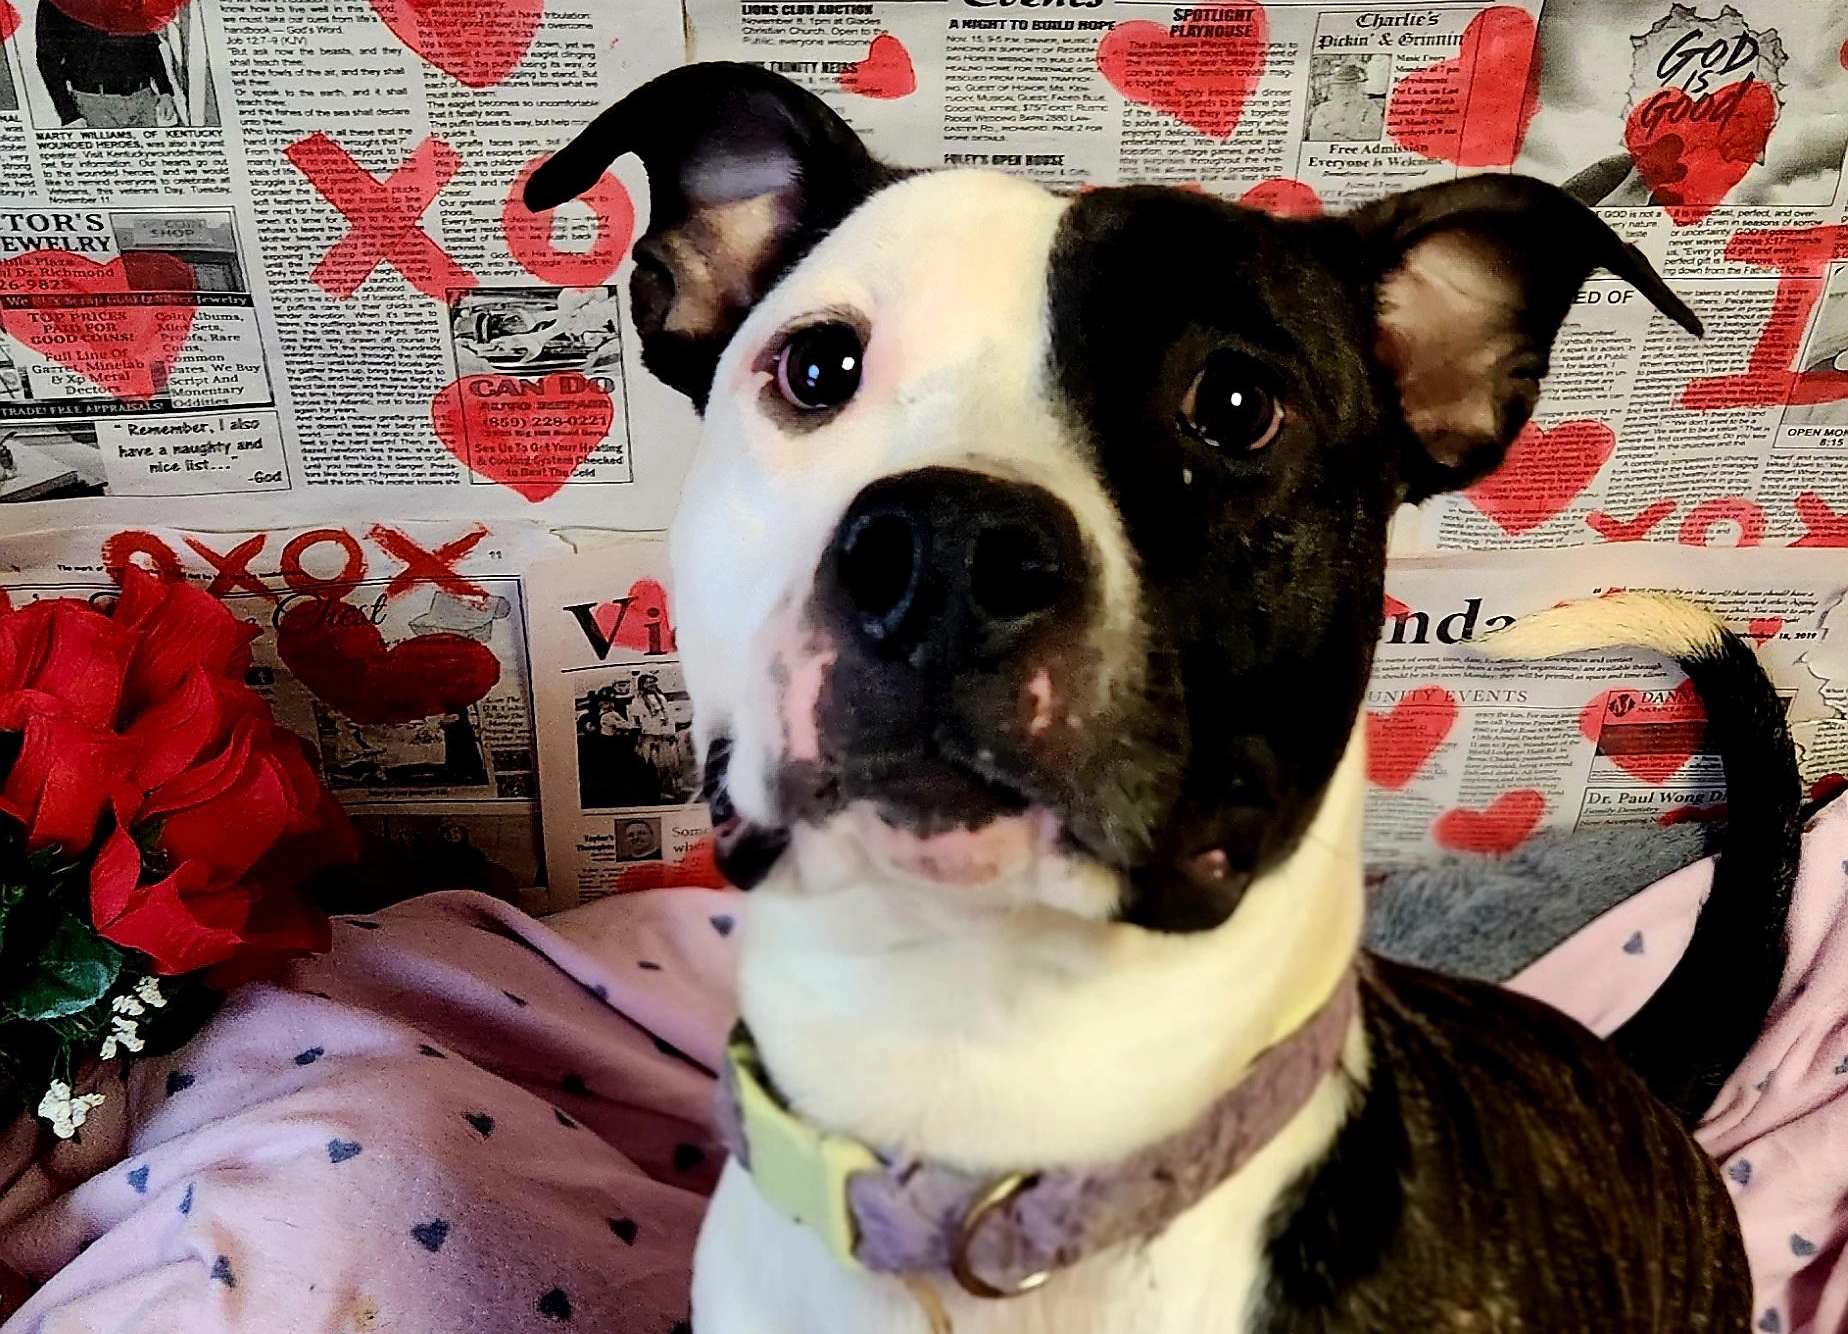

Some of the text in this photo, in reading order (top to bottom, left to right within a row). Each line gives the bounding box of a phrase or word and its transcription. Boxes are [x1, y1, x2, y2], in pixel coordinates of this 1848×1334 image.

[1172, 7, 1256, 23] SPOTLIGHT
[1355, 11, 1440, 29] Charlie's
[1656, 28, 1760, 88] GOD
[1328, 142, 1359, 154] Free
[1606, 290, 1635, 305] OF
[165, 353, 226, 364] Common
[468, 375, 616, 398] CAN DO
[172, 437, 264, 458] naughty and
[562, 596, 678, 662] Vi
[1445, 689, 1529, 704] EVENTS
[1586, 790, 1706, 808] Dr. Paul Wong
